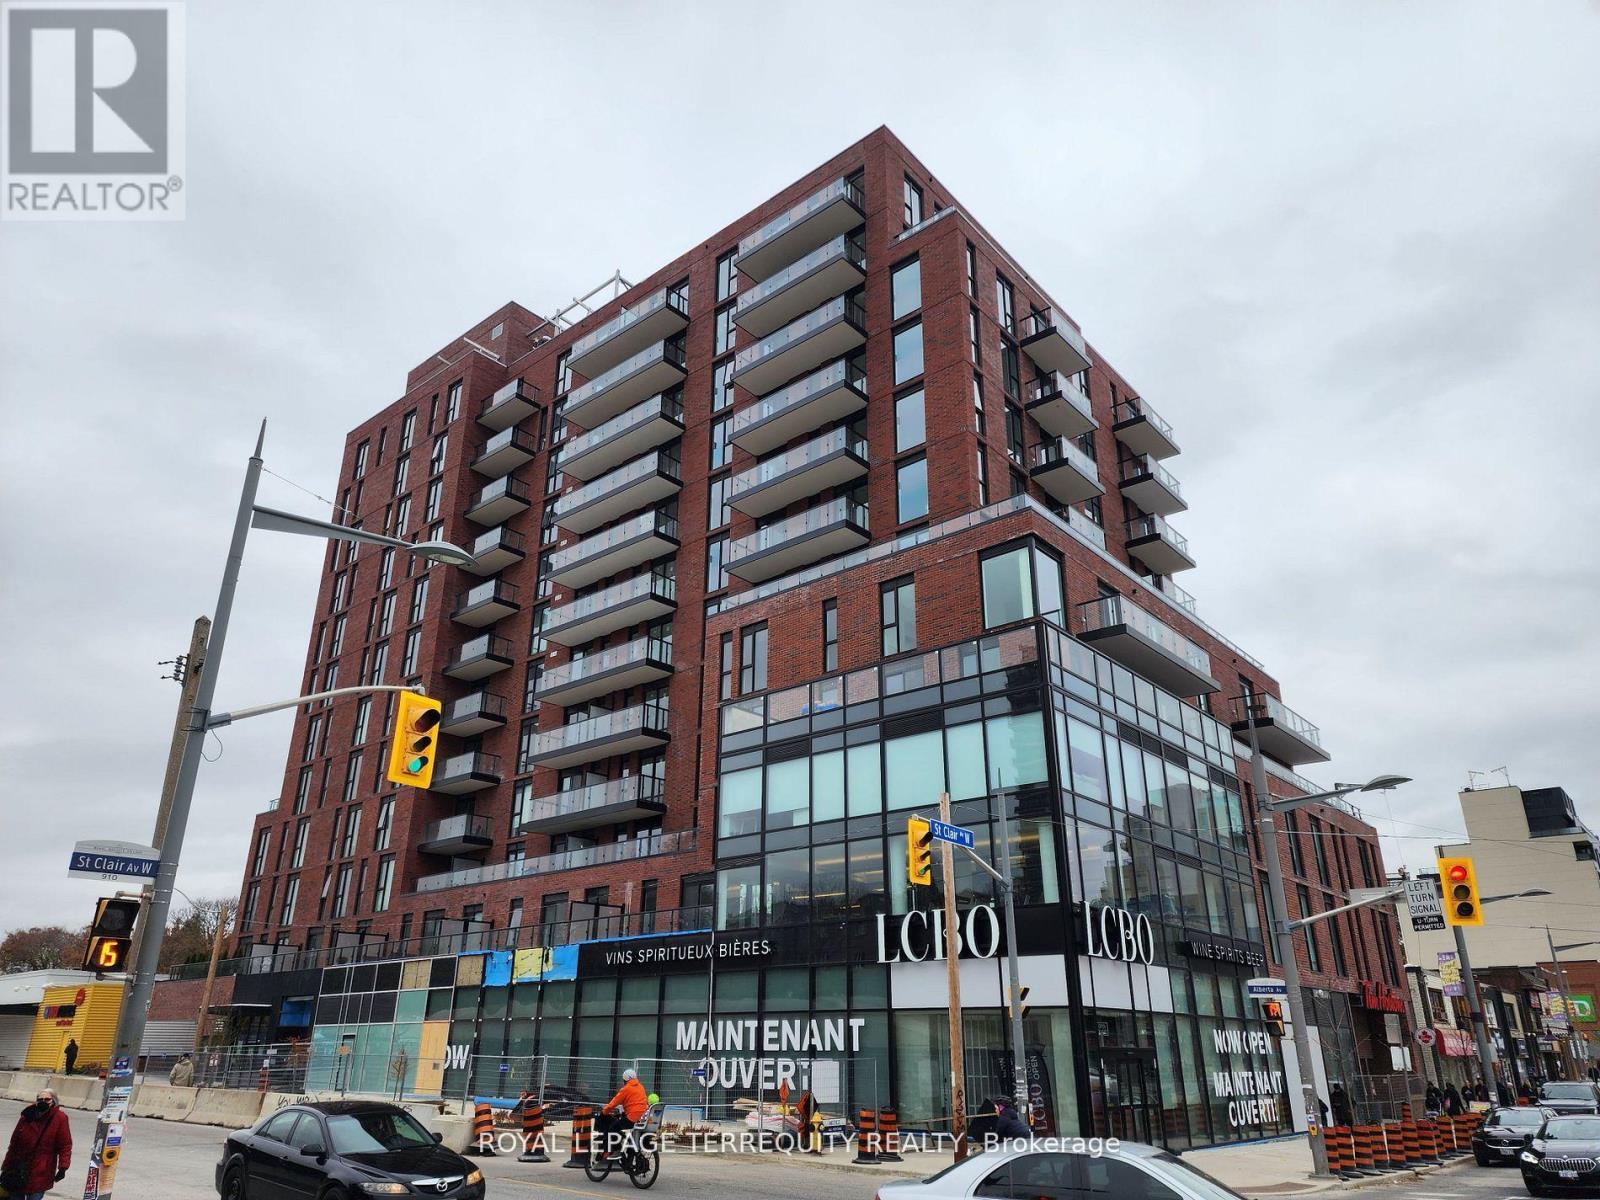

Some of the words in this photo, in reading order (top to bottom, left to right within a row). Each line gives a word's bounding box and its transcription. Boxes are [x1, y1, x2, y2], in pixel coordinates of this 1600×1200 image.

[934, 823, 942, 836] St
[943, 825, 958, 840] Clair
[964, 832, 970, 844] W
[77, 855, 91, 868] St
[94, 857, 126, 872] Clair
[126, 863, 140, 873] Av
[141, 861, 153, 874] W
[101, 873, 118, 881] 910
[1407, 881, 1430, 892] LEFT
[1409, 892, 1435, 903] TURN
[1410, 903, 1440, 914] SIGNAL
[875, 904, 1000, 964] LCBO
[1083, 900, 1154, 965] LCBO
[605, 949, 633, 965] VINS
[637, 944, 714, 963] SPIRITUEUX
[718, 938, 771, 957] BIÈRES
[1191, 941, 1214, 959] WINE
[1215, 945, 1245, 964] SPIRITS
[676, 1018, 865, 1052] MAINTENANT
[1213, 1028, 1242, 1054] NOW
[1242, 1031, 1273, 1055] OPEN
[1030, 1055, 1040, 1080] OPEN
[1212, 1071, 1282, 1097] MAINTENANT
[1030, 1083, 1048, 1130] LCBO
